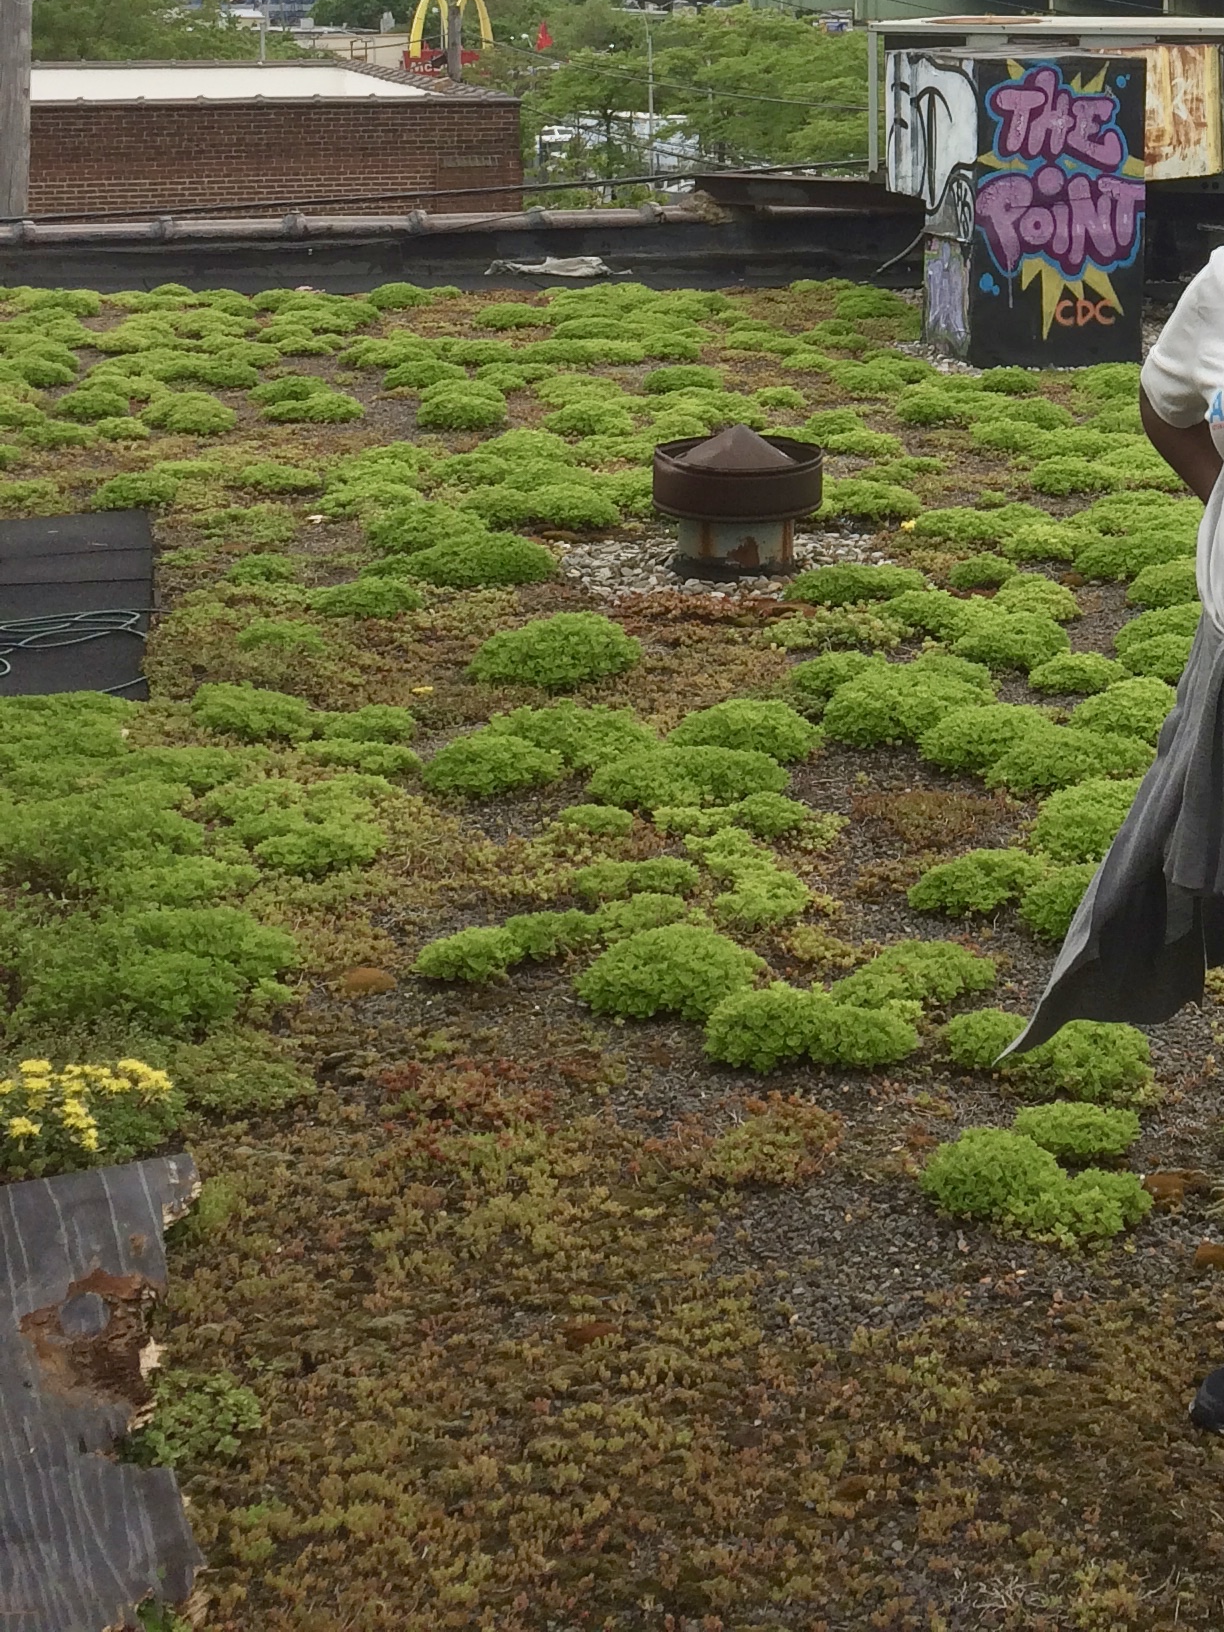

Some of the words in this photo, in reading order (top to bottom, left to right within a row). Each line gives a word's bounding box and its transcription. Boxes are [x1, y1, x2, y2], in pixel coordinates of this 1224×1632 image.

[992, 65, 1124, 171] THE
[974, 166, 1146, 270] POINT
[1054, 298, 1116, 326] CDC
